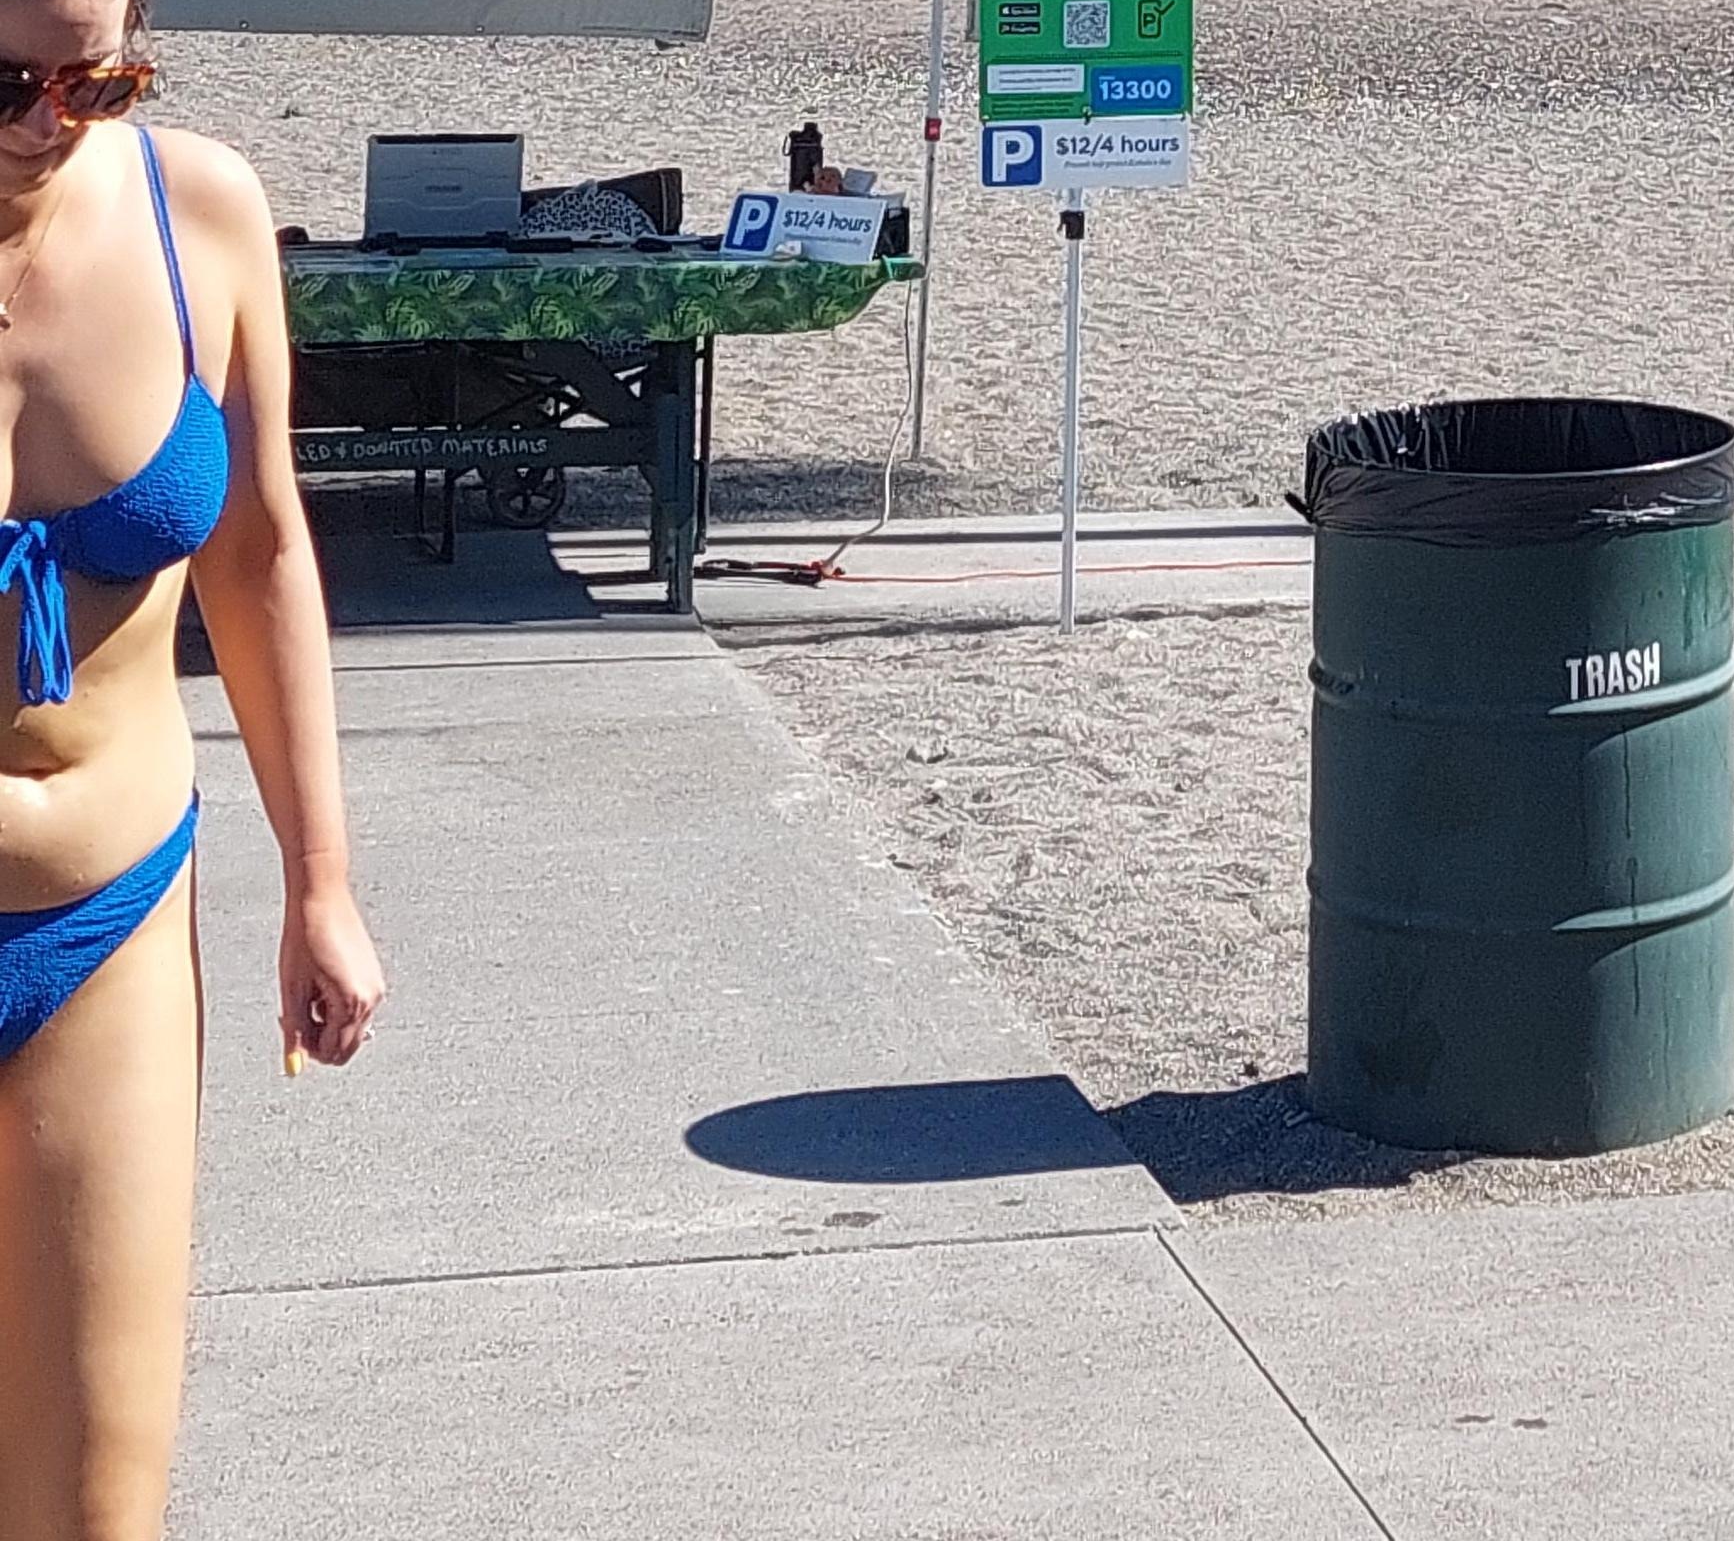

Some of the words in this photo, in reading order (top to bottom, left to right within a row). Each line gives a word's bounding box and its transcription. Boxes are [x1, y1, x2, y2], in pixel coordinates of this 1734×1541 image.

[1100, 79, 1172, 101] 13300
[992, 130, 1034, 182] P
[1056, 133, 1113, 157] $12/4
[1121, 134, 1180, 153] hours
[732, 198, 771, 246] P
[783, 209, 825, 231] $12/4
[828, 210, 873, 233] hours
[297, 443, 331, 461] LED
[442, 437, 549, 458] MATERIALS
[1565, 641, 1660, 701] TRASH
